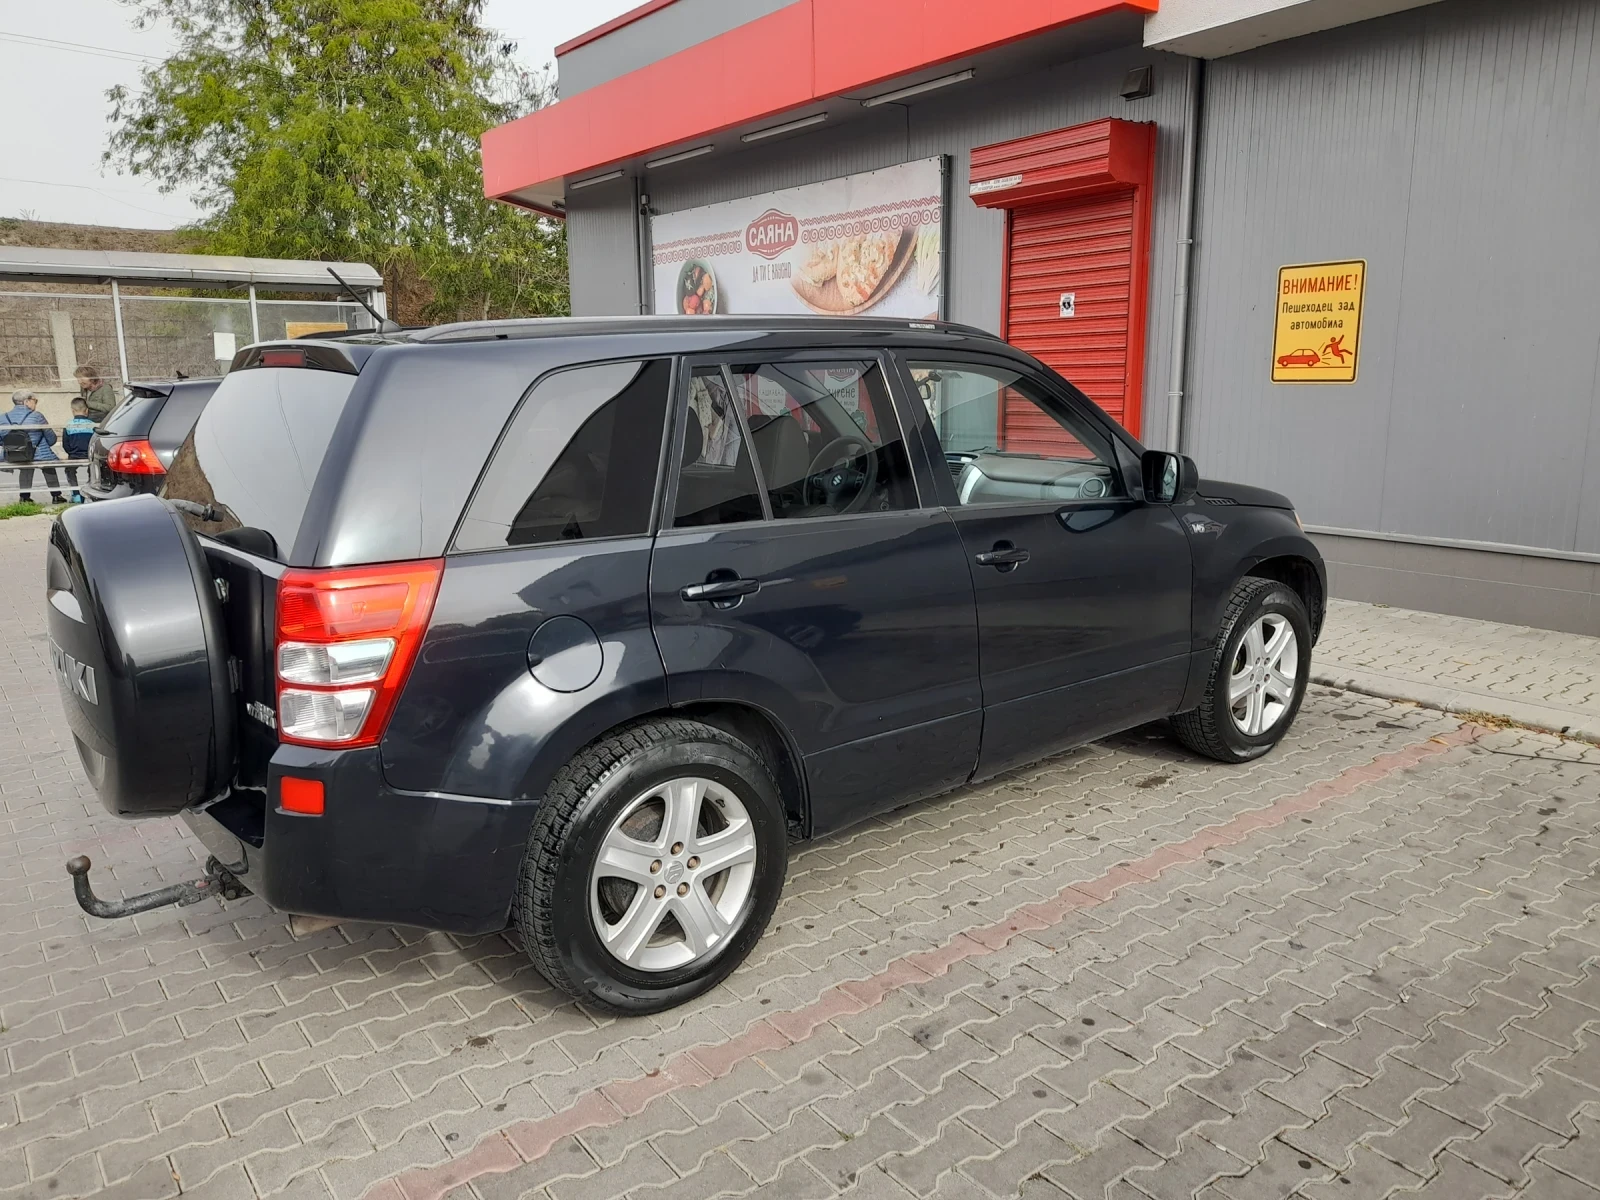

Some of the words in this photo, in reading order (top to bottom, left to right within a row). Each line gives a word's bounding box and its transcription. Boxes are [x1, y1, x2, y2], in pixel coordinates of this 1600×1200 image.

[749, 221, 795, 247] САЯНА
[1282, 273, 1358, 295] ВНИМАНИЕ!
[1282, 301, 1333, 314] Пешеходец
[1337, 301, 1355, 311] зад
[1290, 316, 1343, 330] автомобила
